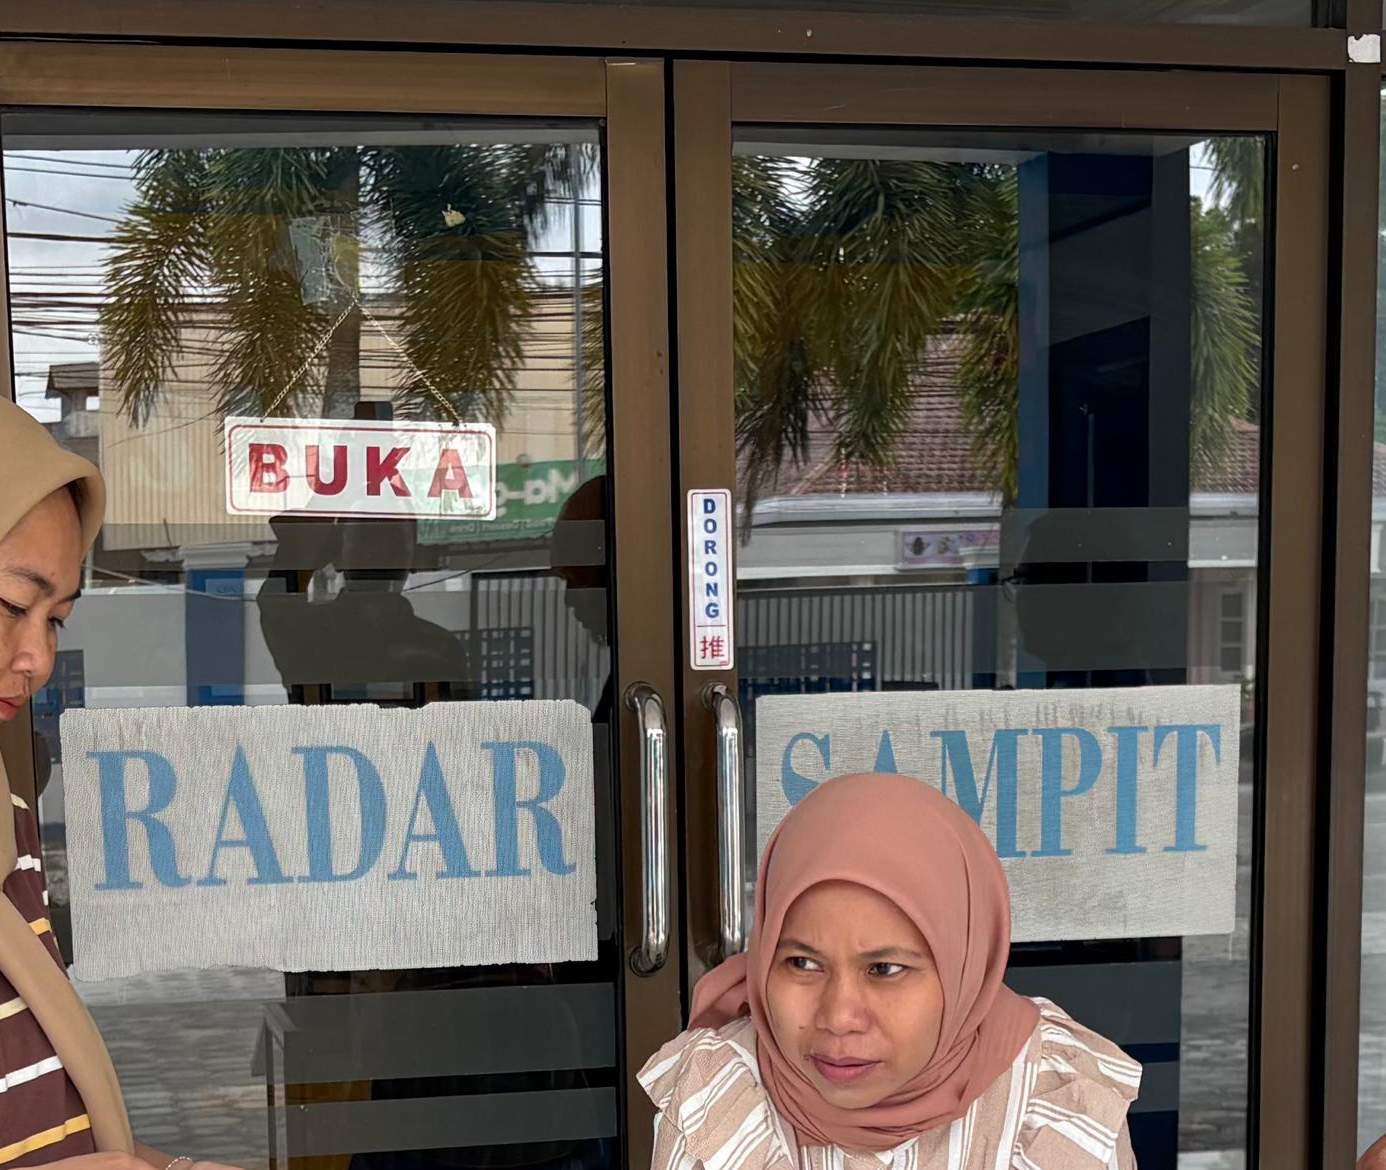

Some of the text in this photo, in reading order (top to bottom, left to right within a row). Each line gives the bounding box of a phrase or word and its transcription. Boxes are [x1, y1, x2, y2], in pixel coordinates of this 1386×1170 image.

[248, 443, 473, 498] BUKA
[703, 498, 720, 619] DORONG
[700, 635, 725, 659] 推
[85, 740, 578, 891] RADAR
